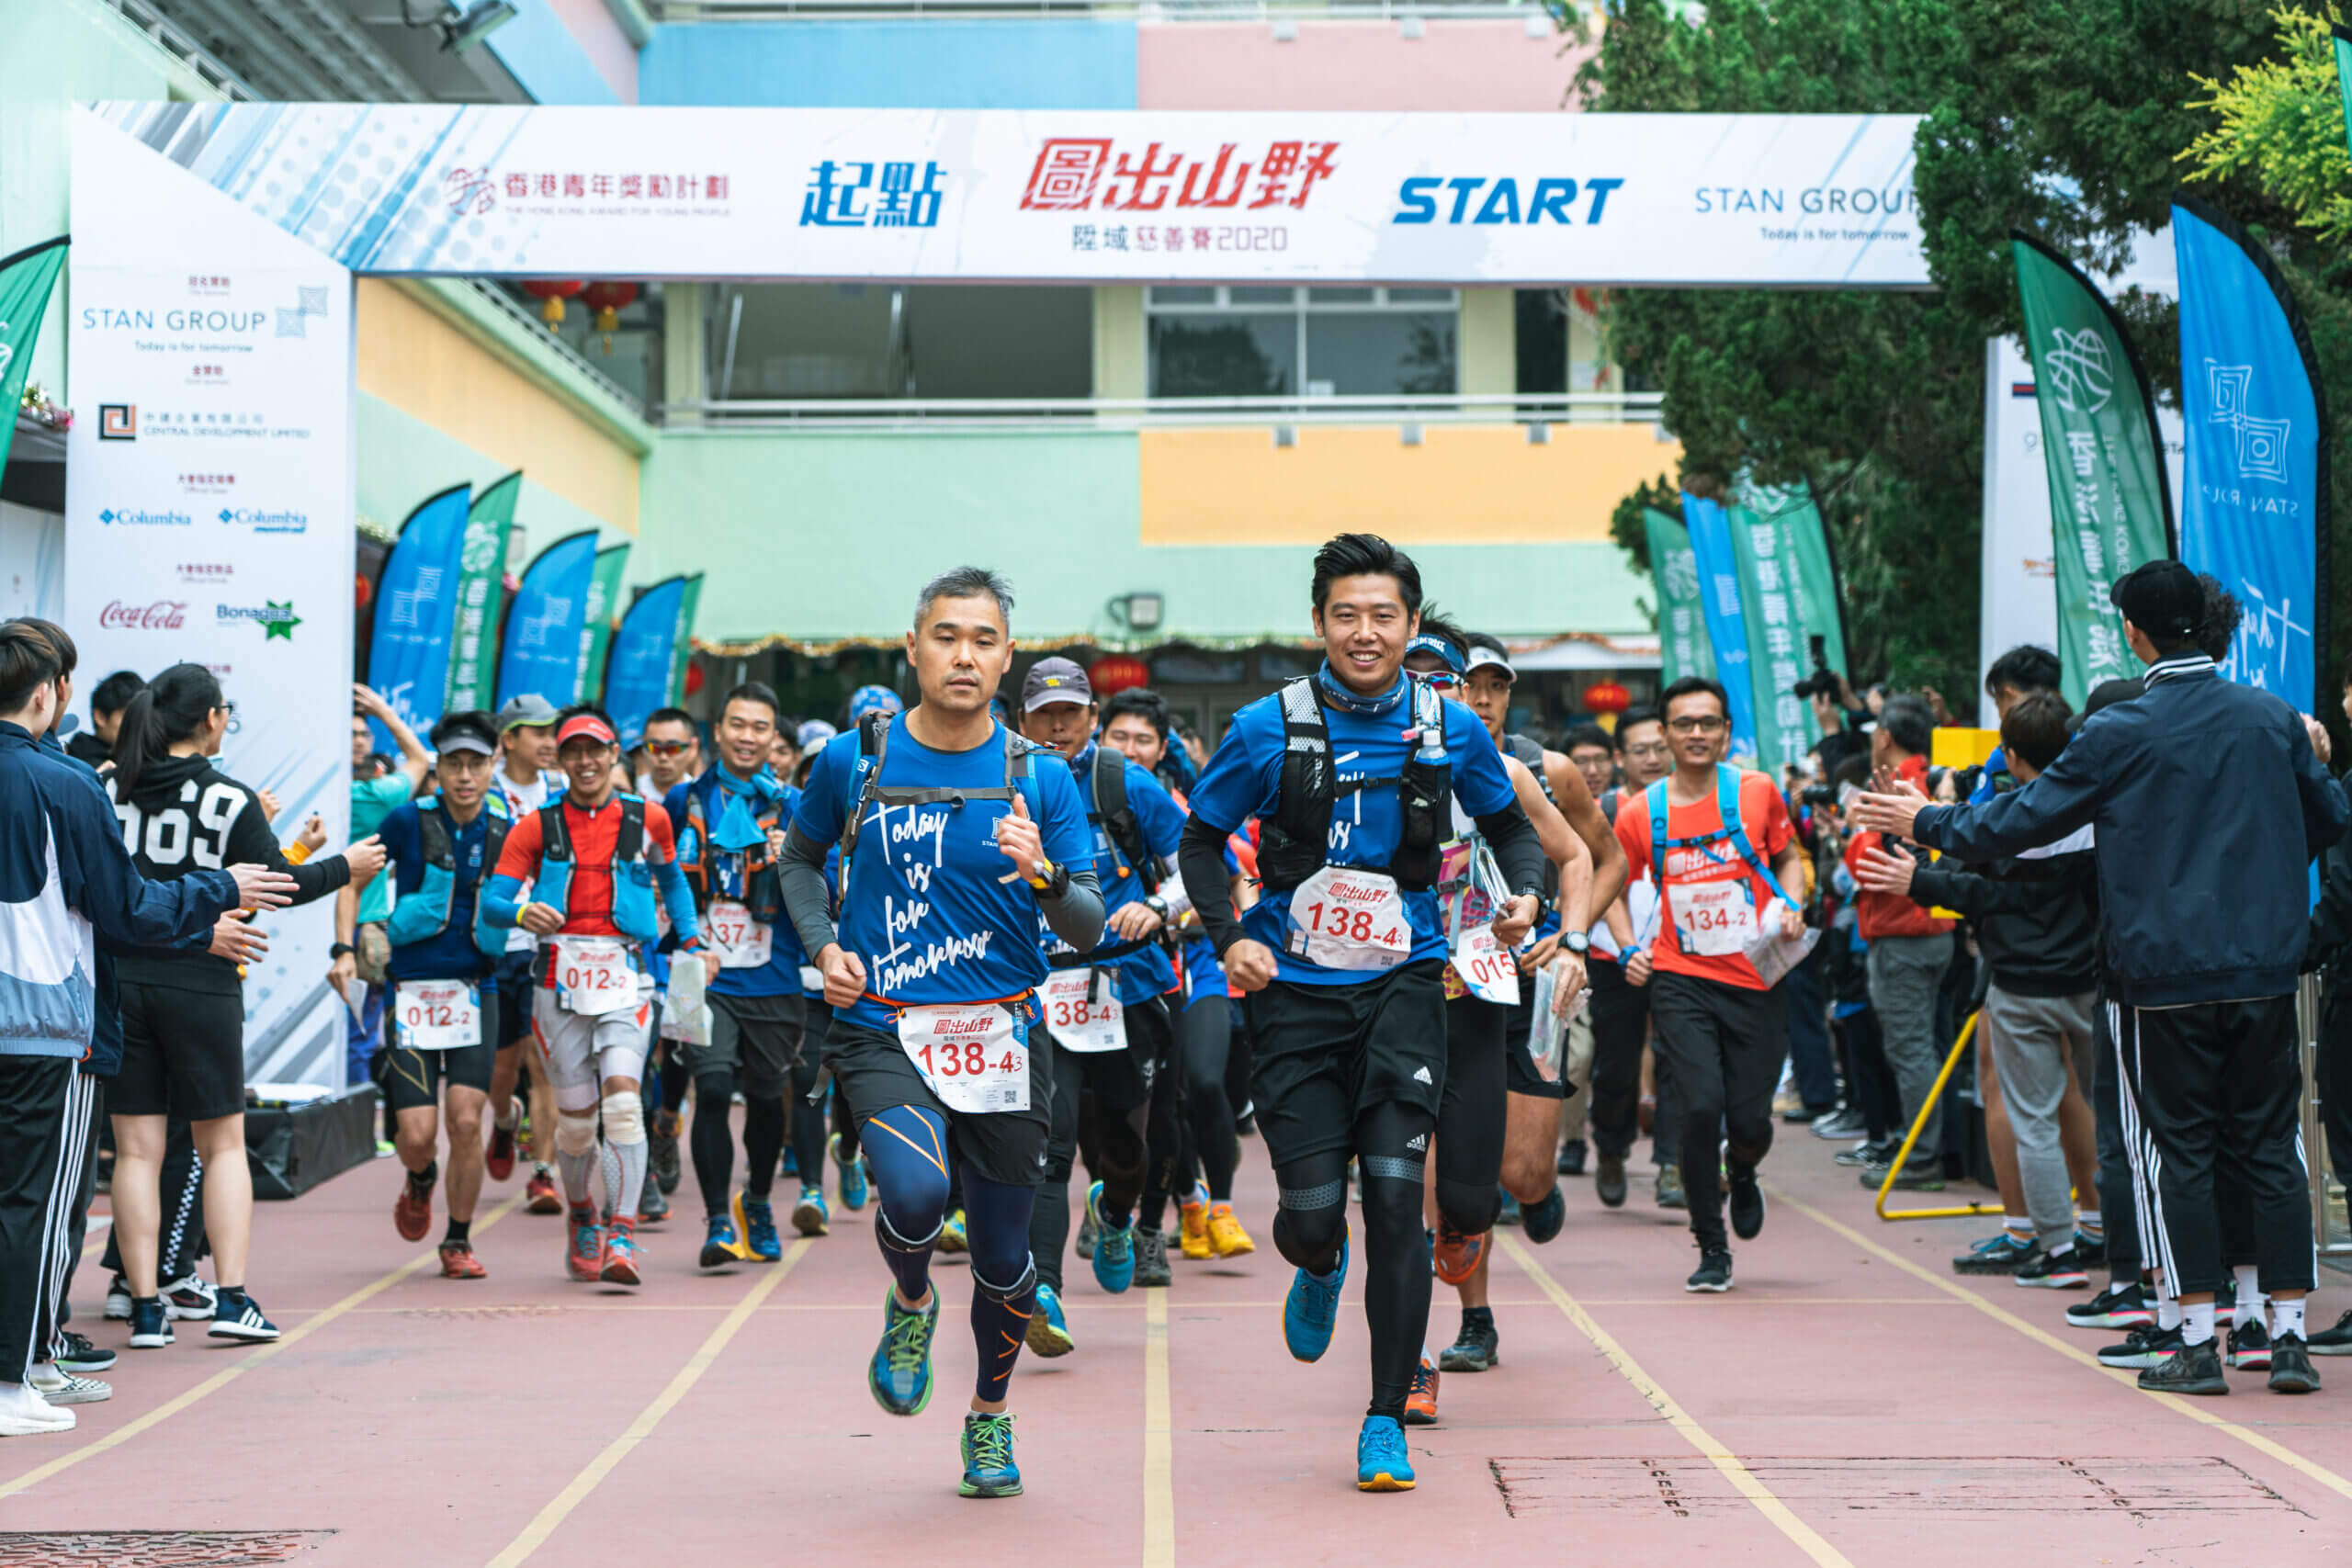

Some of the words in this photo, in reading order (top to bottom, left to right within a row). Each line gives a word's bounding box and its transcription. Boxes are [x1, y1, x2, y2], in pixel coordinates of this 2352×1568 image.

[1019, 138, 1342, 211] 圖出山野
[799, 161, 947, 228] 起點
[1392, 177, 1625, 224] START
[1695, 187, 1784, 213] STAN
[1760, 228, 1799, 243] Today
[1804, 228, 1815, 240] is
[1818, 228, 1837, 240] for
[1841, 229, 1909, 242] tomorrow
[83, 308, 154, 330] STAN
[166, 310, 266, 332] GROUP
[135, 341, 164, 352] Today
[168, 341, 177, 351] is
[181, 341, 196, 351] for
[199, 343, 254, 353] tomorrow
[117, 509, 191, 526] Columbia
[234, 508, 307, 525] Columbia
[862, 801, 949, 868] Today
[903, 852, 933, 893] is
[884, 895, 930, 964] for
[1684, 908, 1747, 931] 134-2
[566, 967, 627, 990] 012-2
[408, 1006, 471, 1027] 012-2
